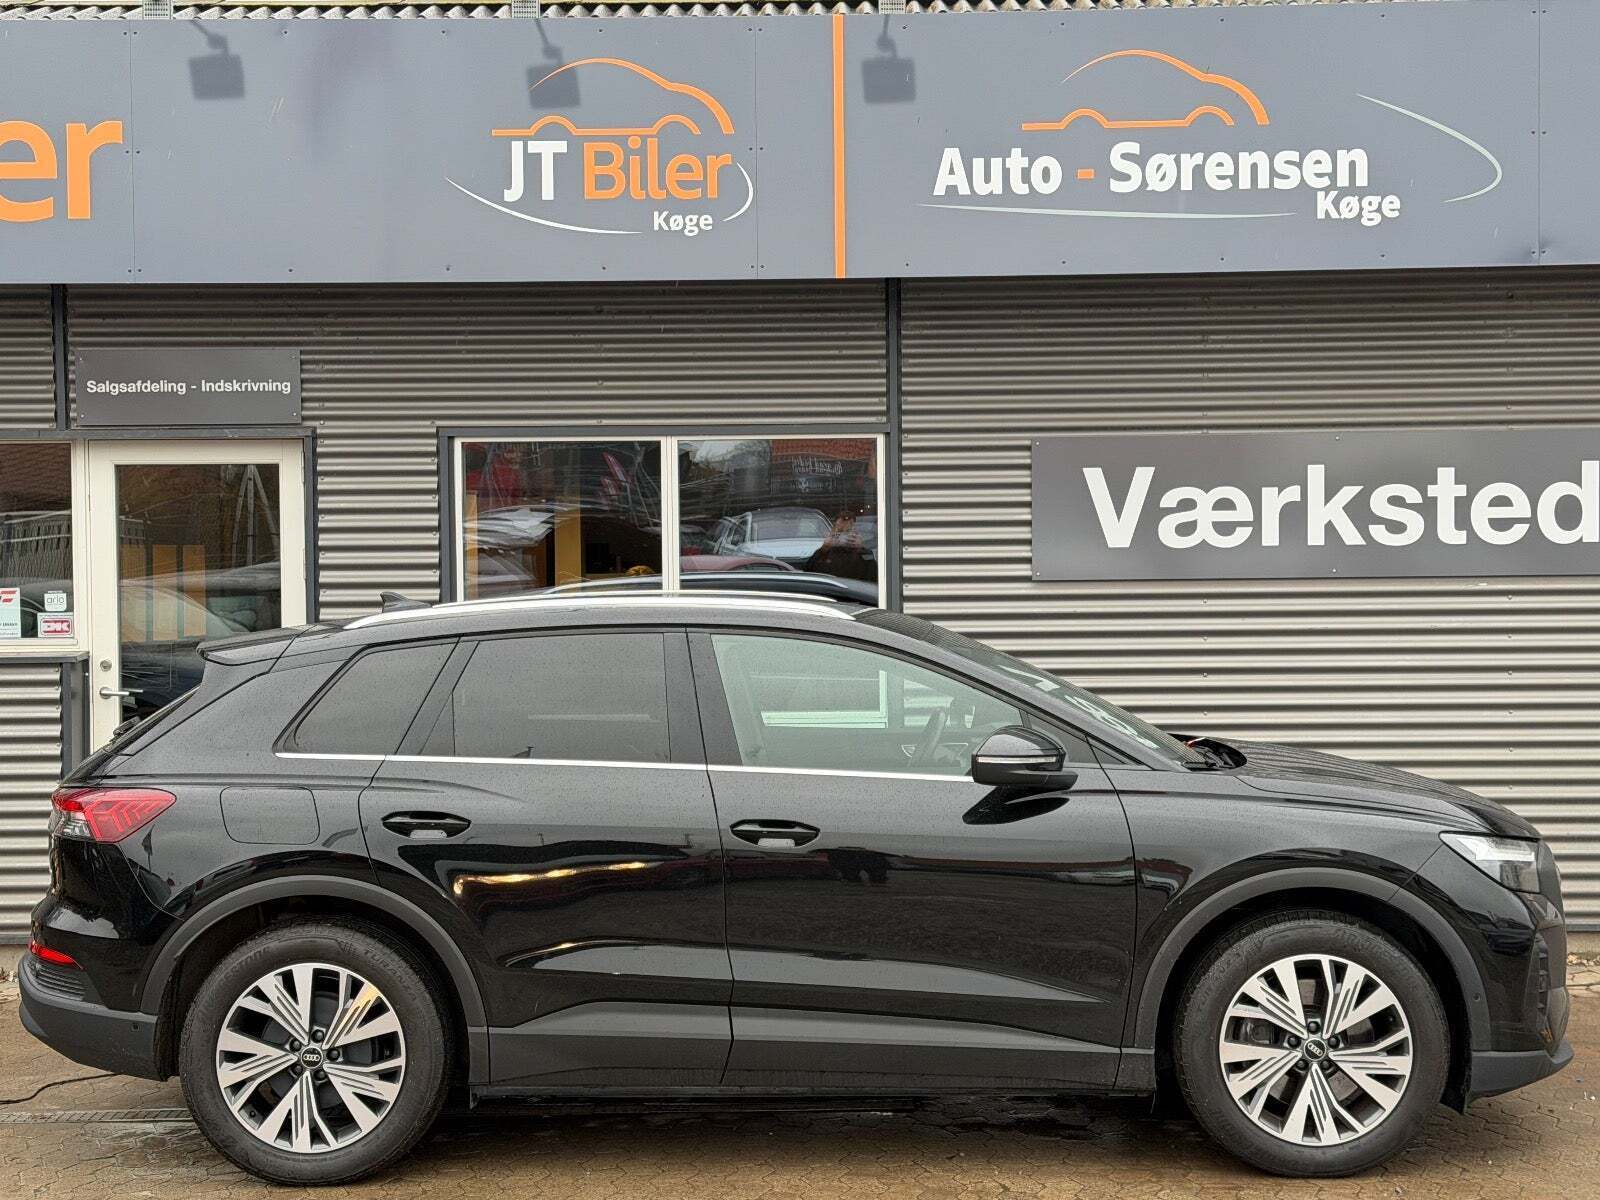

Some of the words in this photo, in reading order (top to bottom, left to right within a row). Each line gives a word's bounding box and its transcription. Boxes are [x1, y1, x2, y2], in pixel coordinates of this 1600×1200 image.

[503, 140, 568, 202] JT
[583, 135, 733, 200] Biler
[932, 147, 1063, 196] Auto
[1077, 168, 1095, 180] -
[1109, 141, 1369, 193] Sørensen
[653, 210, 714, 237] Køge
[1316, 190, 1401, 227] Køge
[86, 379, 187, 396] Salgsafdeling
[201, 378, 291, 395] Indskrivning
[1081, 459, 1600, 549] Værksted
